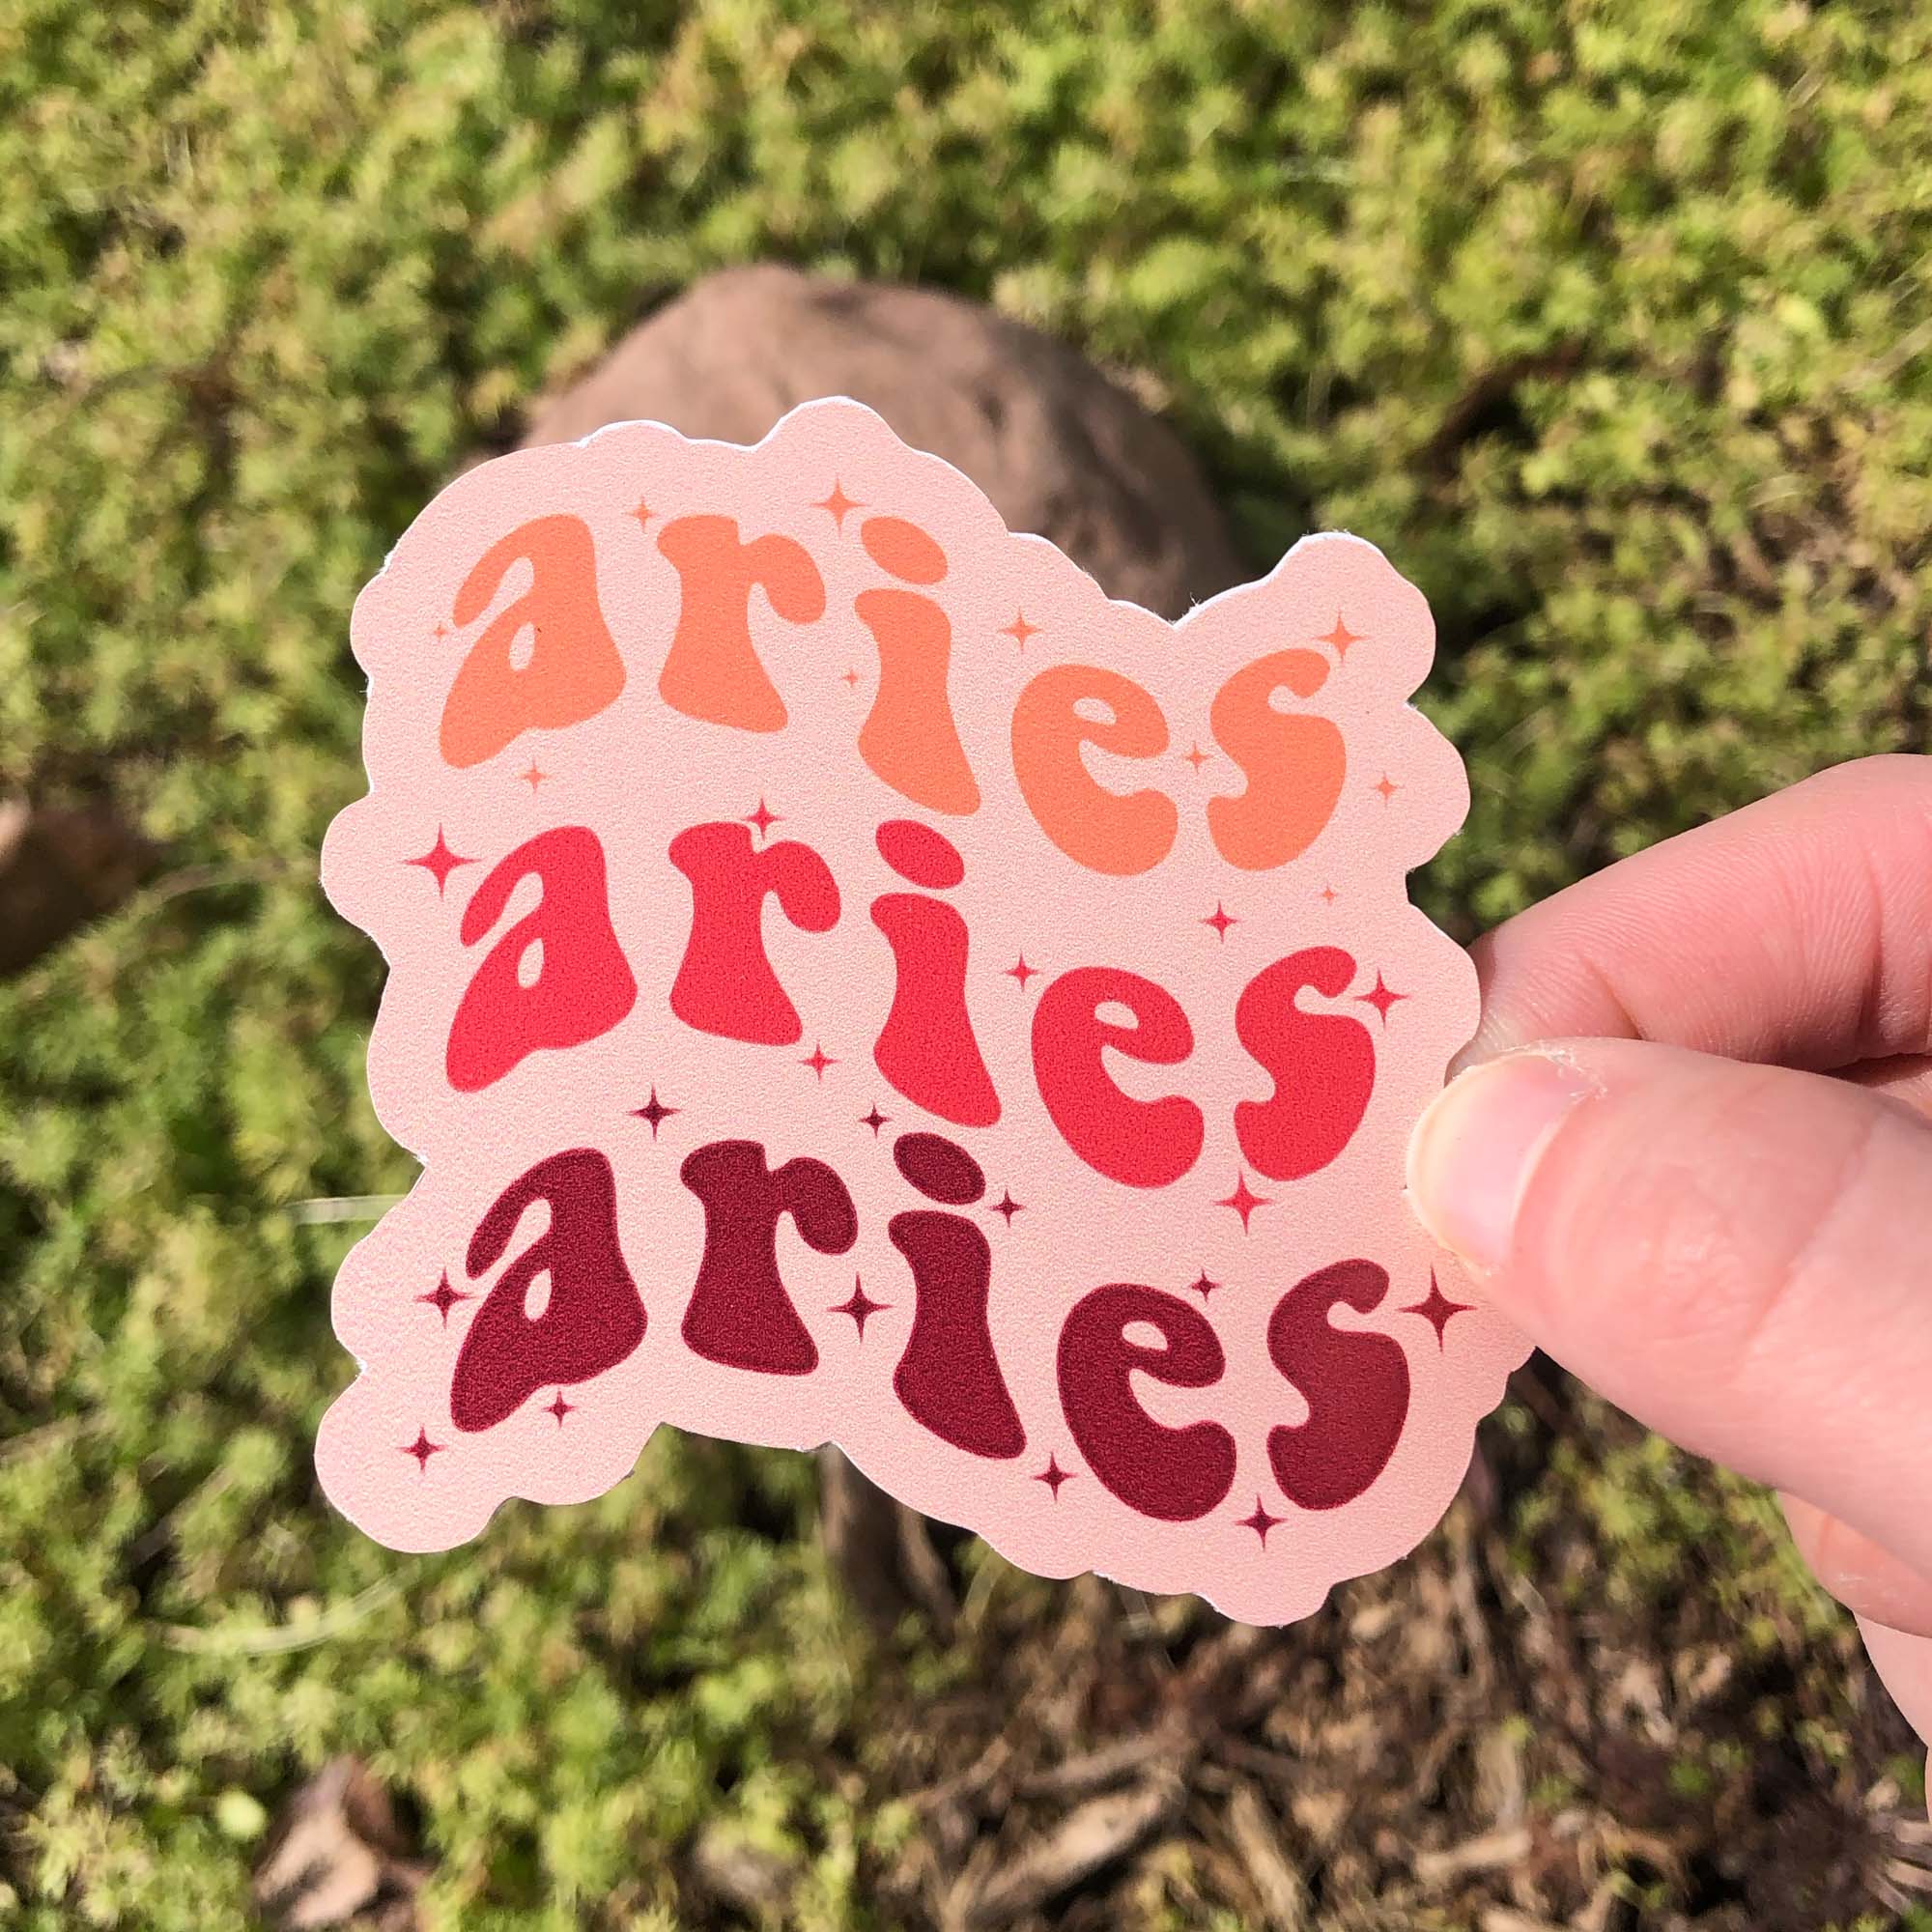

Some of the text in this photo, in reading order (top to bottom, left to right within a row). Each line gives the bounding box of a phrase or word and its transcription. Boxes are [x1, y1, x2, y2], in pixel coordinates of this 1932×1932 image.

[440, 514, 1348, 876] aries
[445, 819, 1377, 1189] aries
[450, 1132, 1410, 1522] aries
